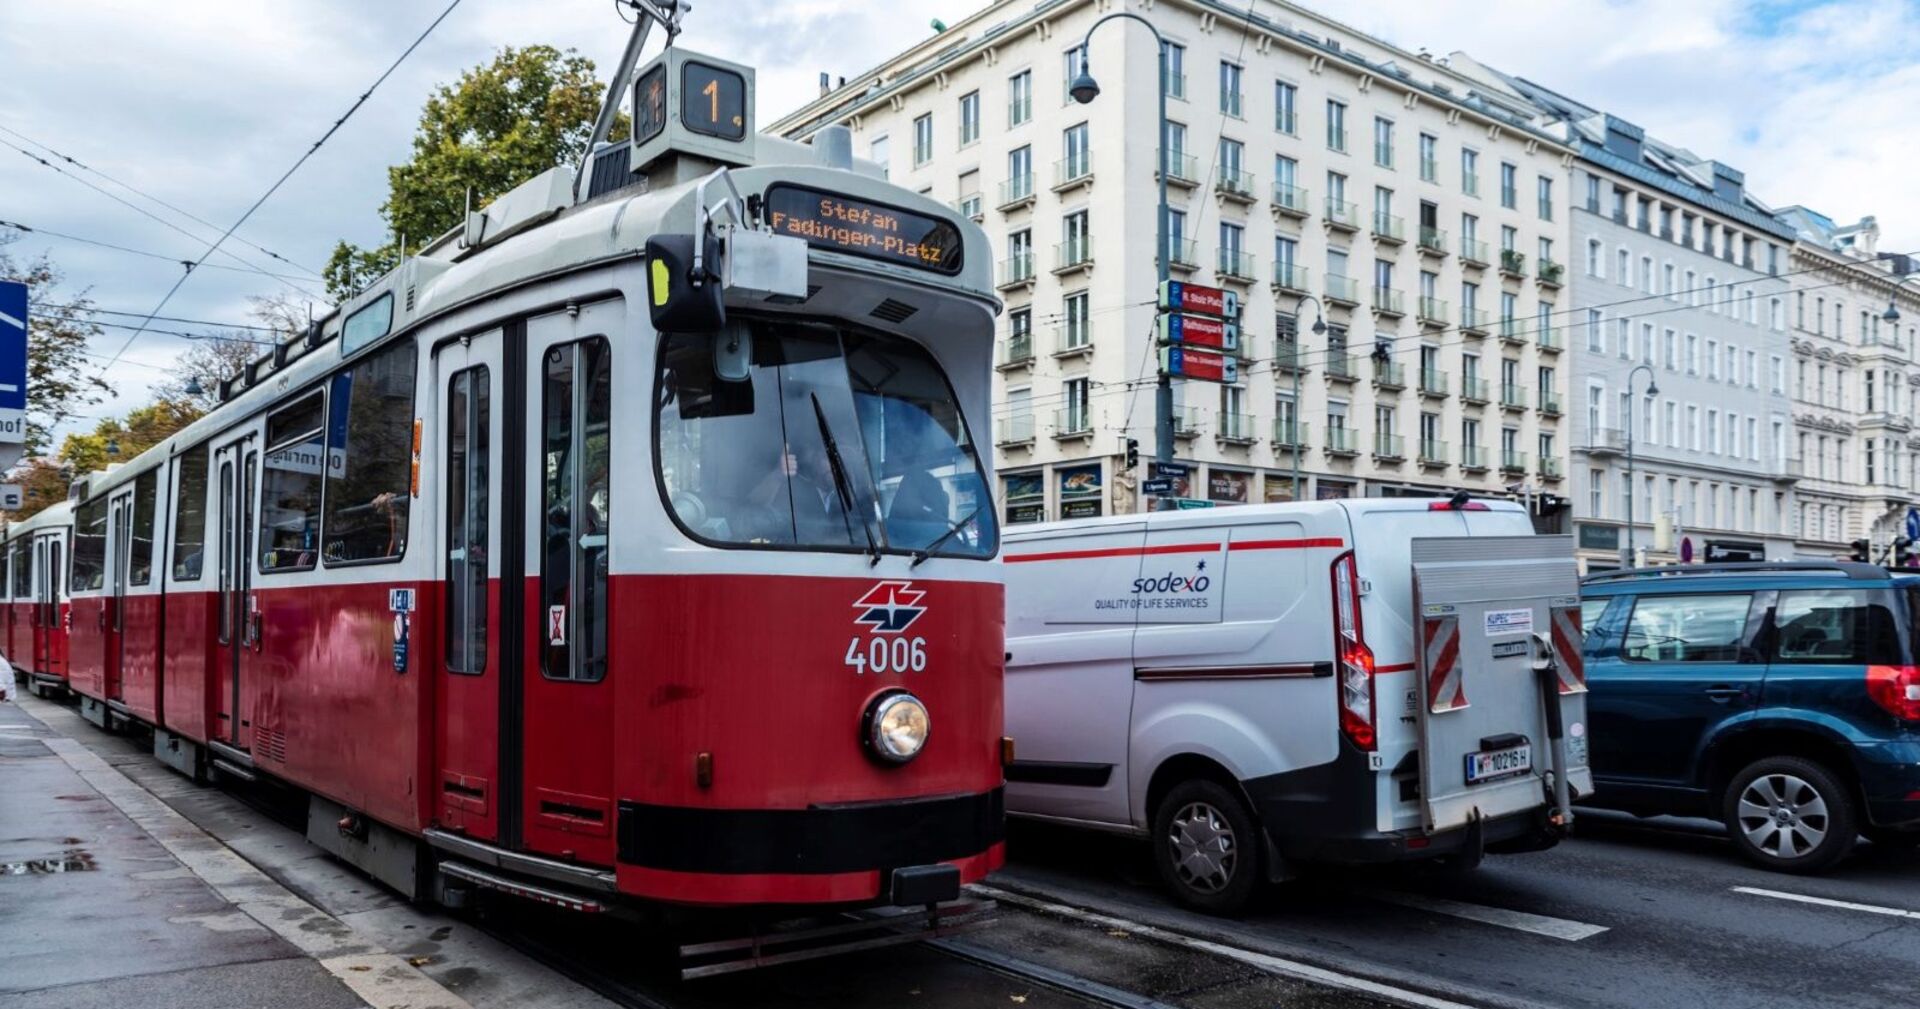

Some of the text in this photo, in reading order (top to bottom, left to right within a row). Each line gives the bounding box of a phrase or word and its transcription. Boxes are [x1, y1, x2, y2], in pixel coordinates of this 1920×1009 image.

[820, 199, 898, 231] Stefan
[772, 211, 942, 262] Fadinger-Platz
[1131, 571, 1210, 593] sodexo
[1095, 597, 1209, 610] QUALITY OF LIFE SERVICES
[845, 637, 926, 674] 4006
